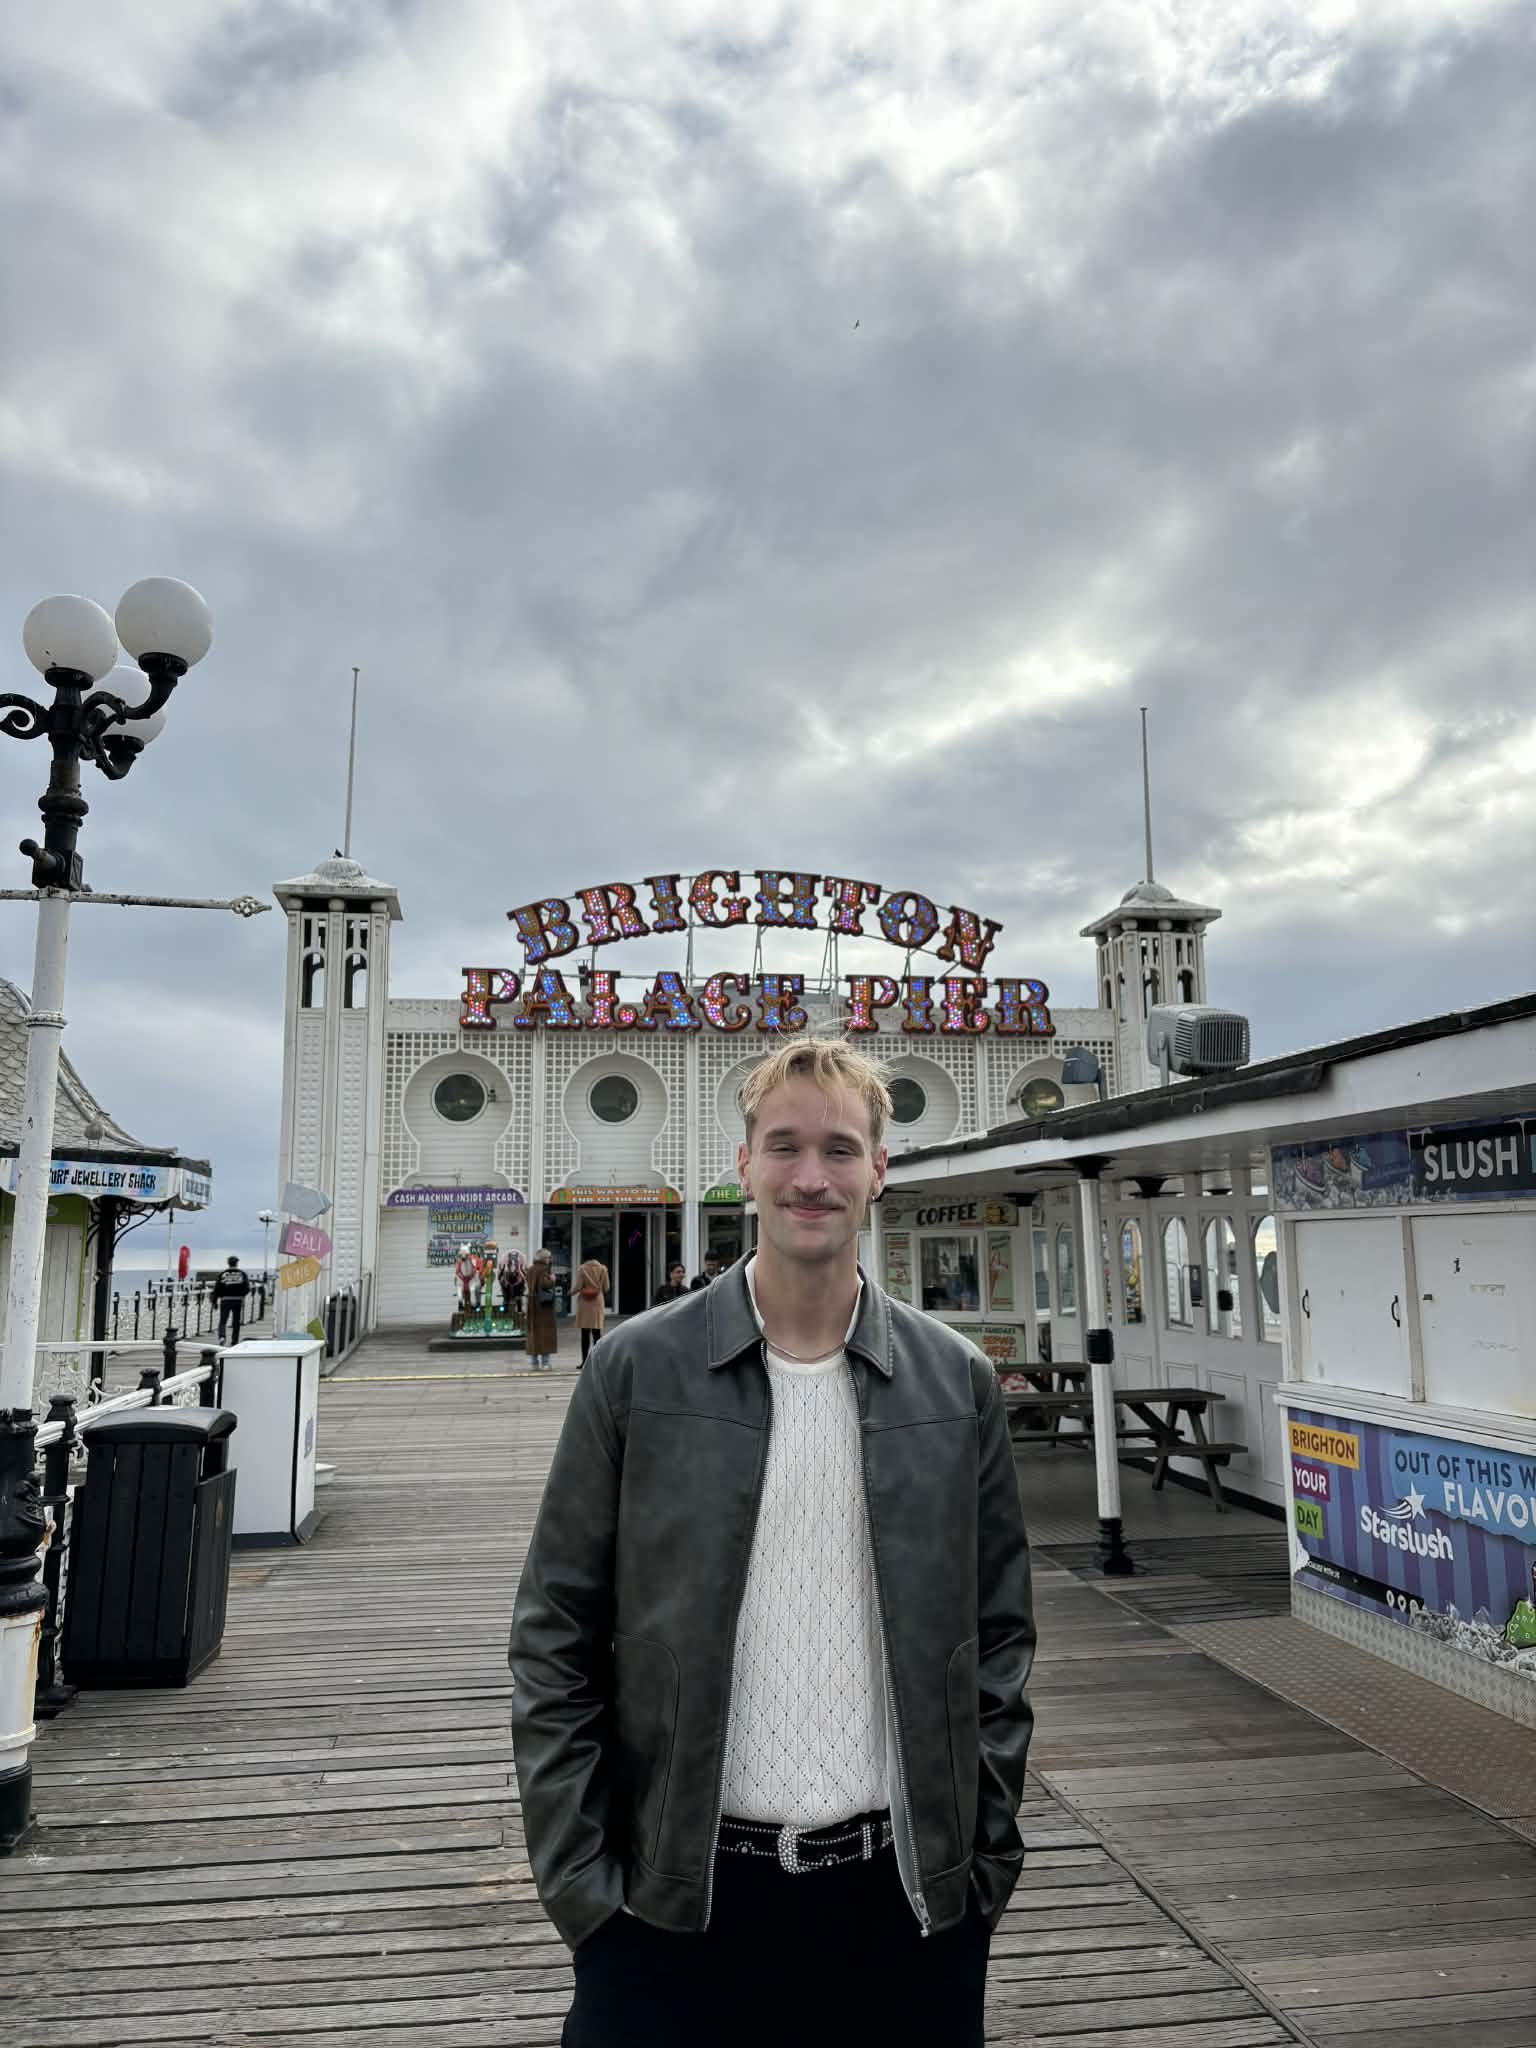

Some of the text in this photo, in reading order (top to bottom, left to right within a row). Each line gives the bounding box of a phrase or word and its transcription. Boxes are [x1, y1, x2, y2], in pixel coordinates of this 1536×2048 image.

[507, 870, 1004, 972] BRIGHTON
[459, 967, 1057, 1037] PALACE PIER
[1424, 1136, 1519, 1182] SLUSH
[49, 1168, 157, 1190] URF JEWELLERY SHACK
[394, 1192, 518, 1204] CASH MACHINE INSIDE ARCADE
[711, 1189, 729, 1201] THE
[917, 1203, 977, 1226] COFFEE
[292, 1231, 322, 1252] BALI
[1292, 1428, 1355, 1460] BRIGHTON
[1294, 1466, 1327, 1495] YOUR
[1395, 1450, 1430, 1475] OUT
[1437, 1454, 1460, 1480] OF
[1465, 1457, 1513, 1488] THIS
[1297, 1505, 1319, 1529] DAY
[1360, 1505, 1454, 1560] Starslush
